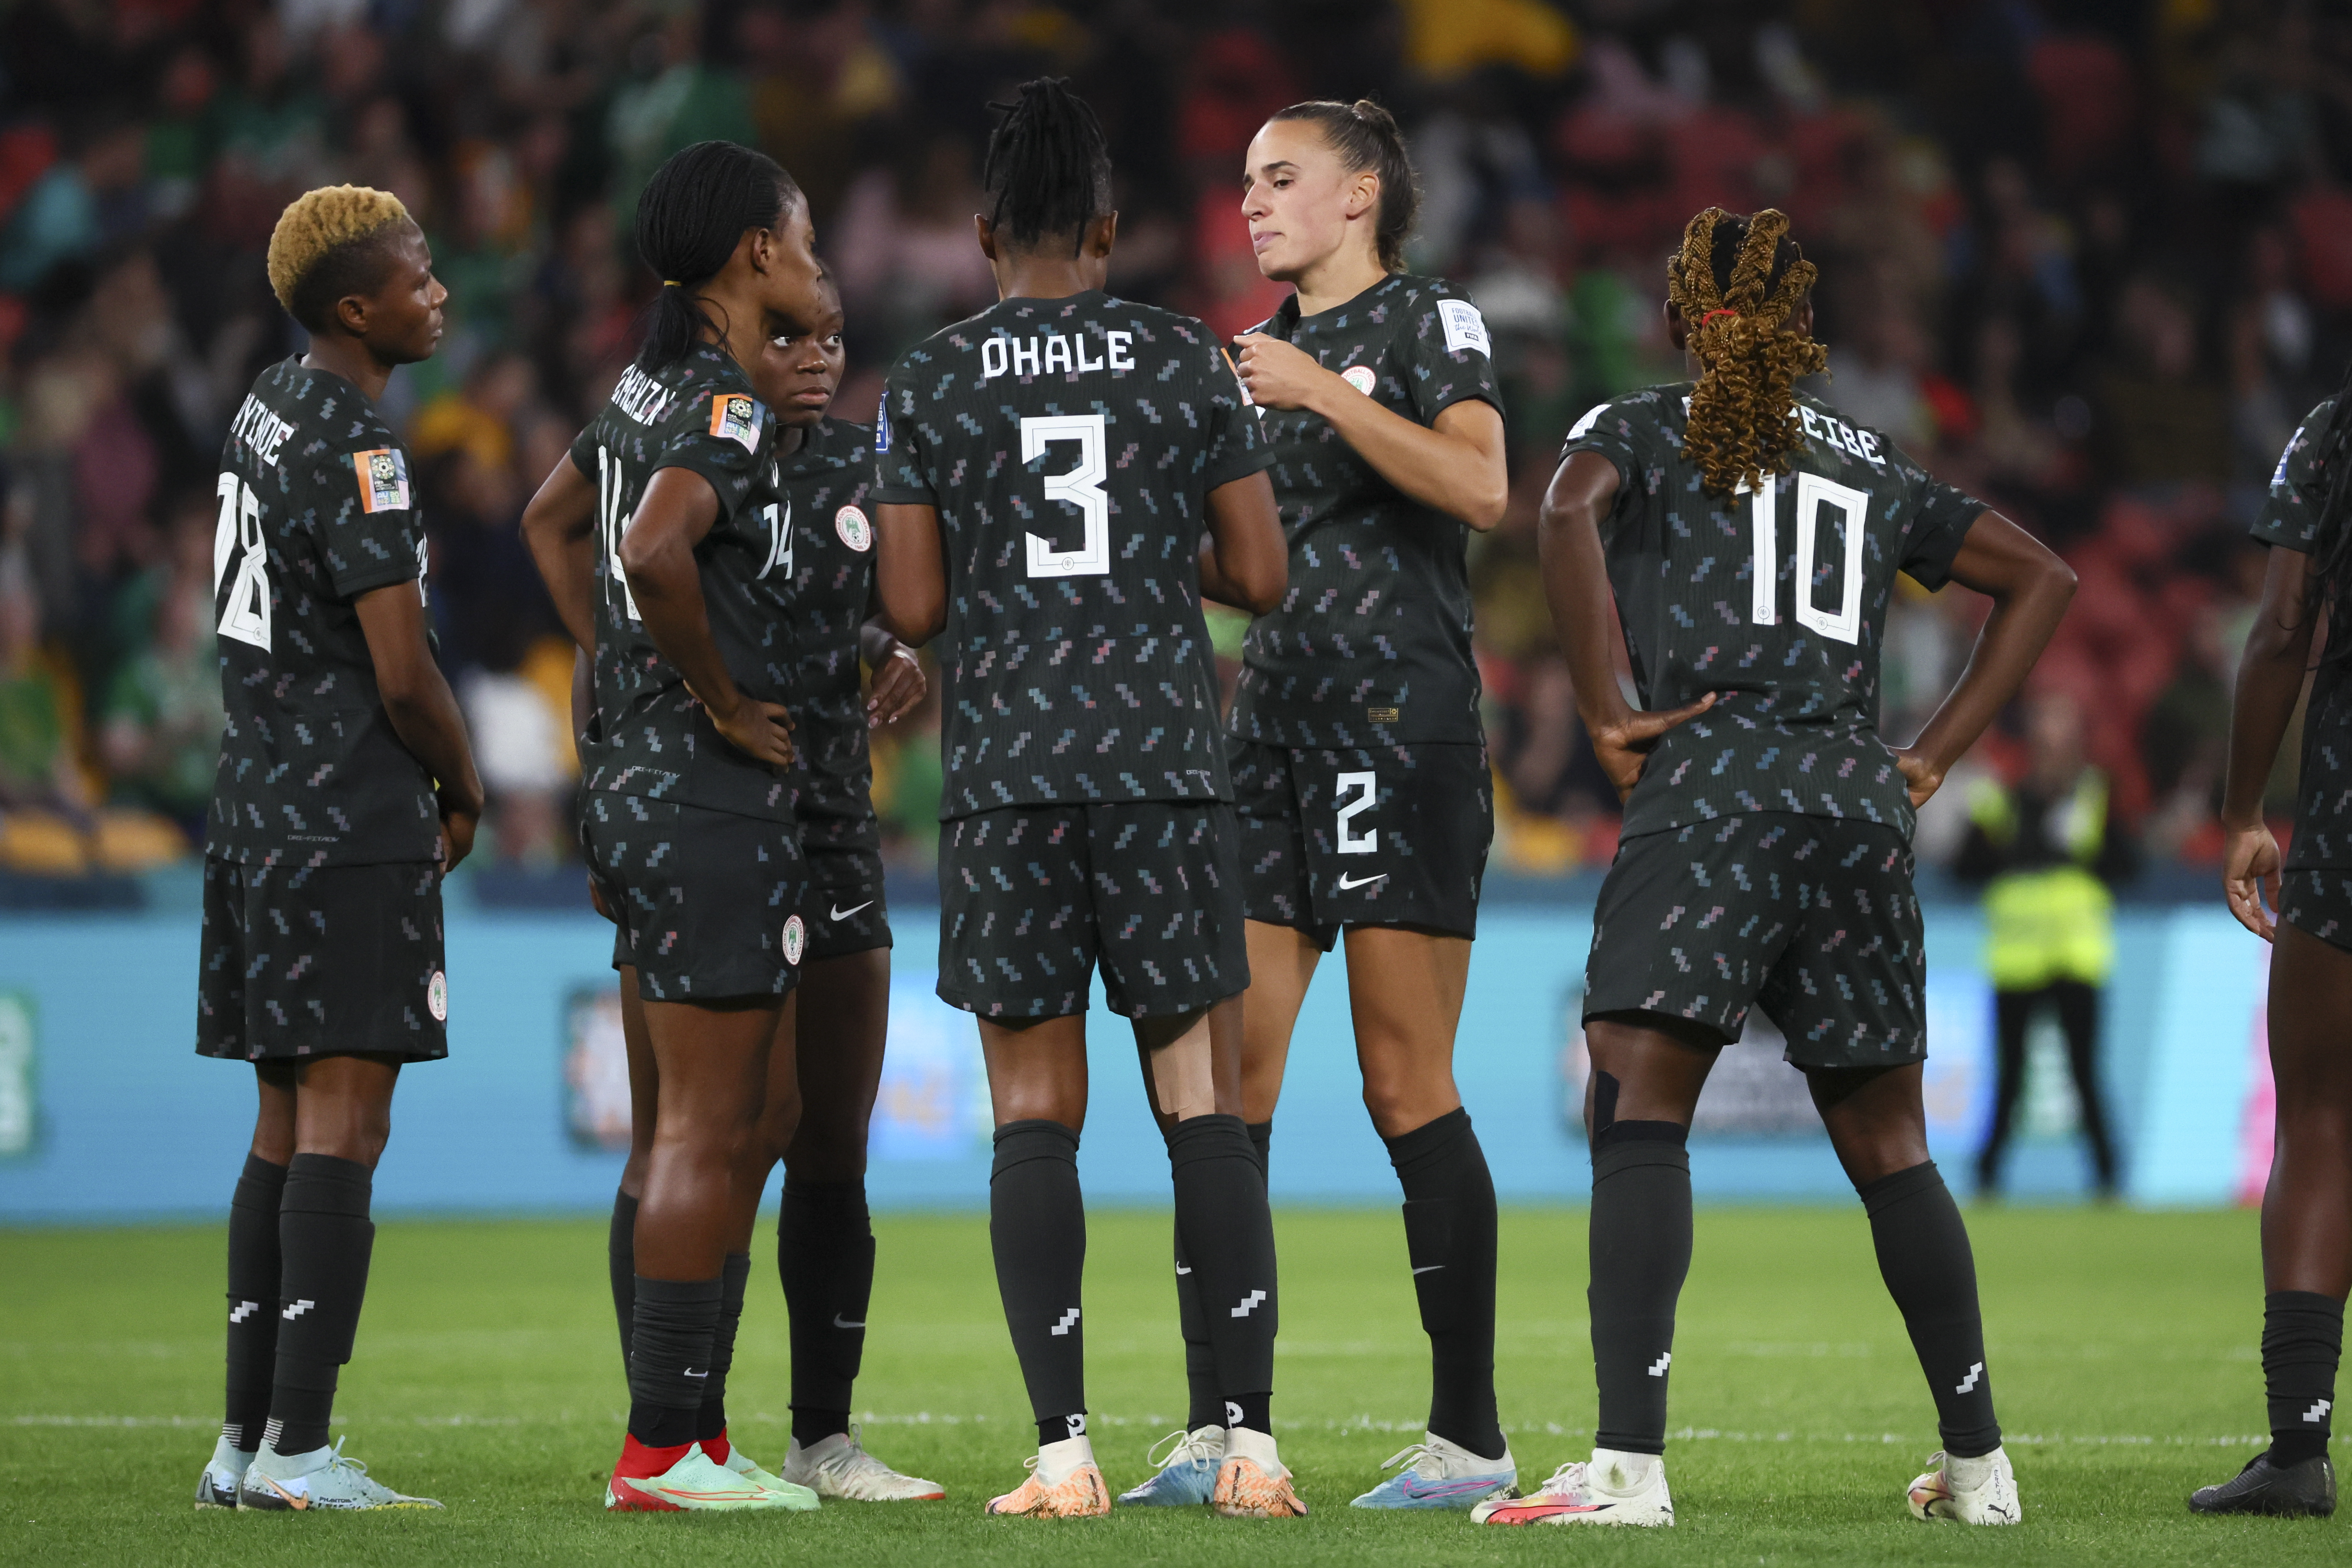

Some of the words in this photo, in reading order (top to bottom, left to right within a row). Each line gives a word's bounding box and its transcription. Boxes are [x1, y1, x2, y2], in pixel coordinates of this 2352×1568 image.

[1452, 308, 1476, 318] FOOTBALL
[1454, 315, 1480, 328] UNITES
[982, 330, 1136, 378] OHALE
[1343, 369, 1365, 379] OOTBALL
[230, 393, 295, 466] AYINDE
[598, 445, 642, 620] 14
[1020, 415, 1109, 578] 3
[214, 472, 271, 654] 18
[756, 500, 793, 579] 14
[1734, 468, 1868, 645] 10
[1336, 771, 1377, 854] 2
